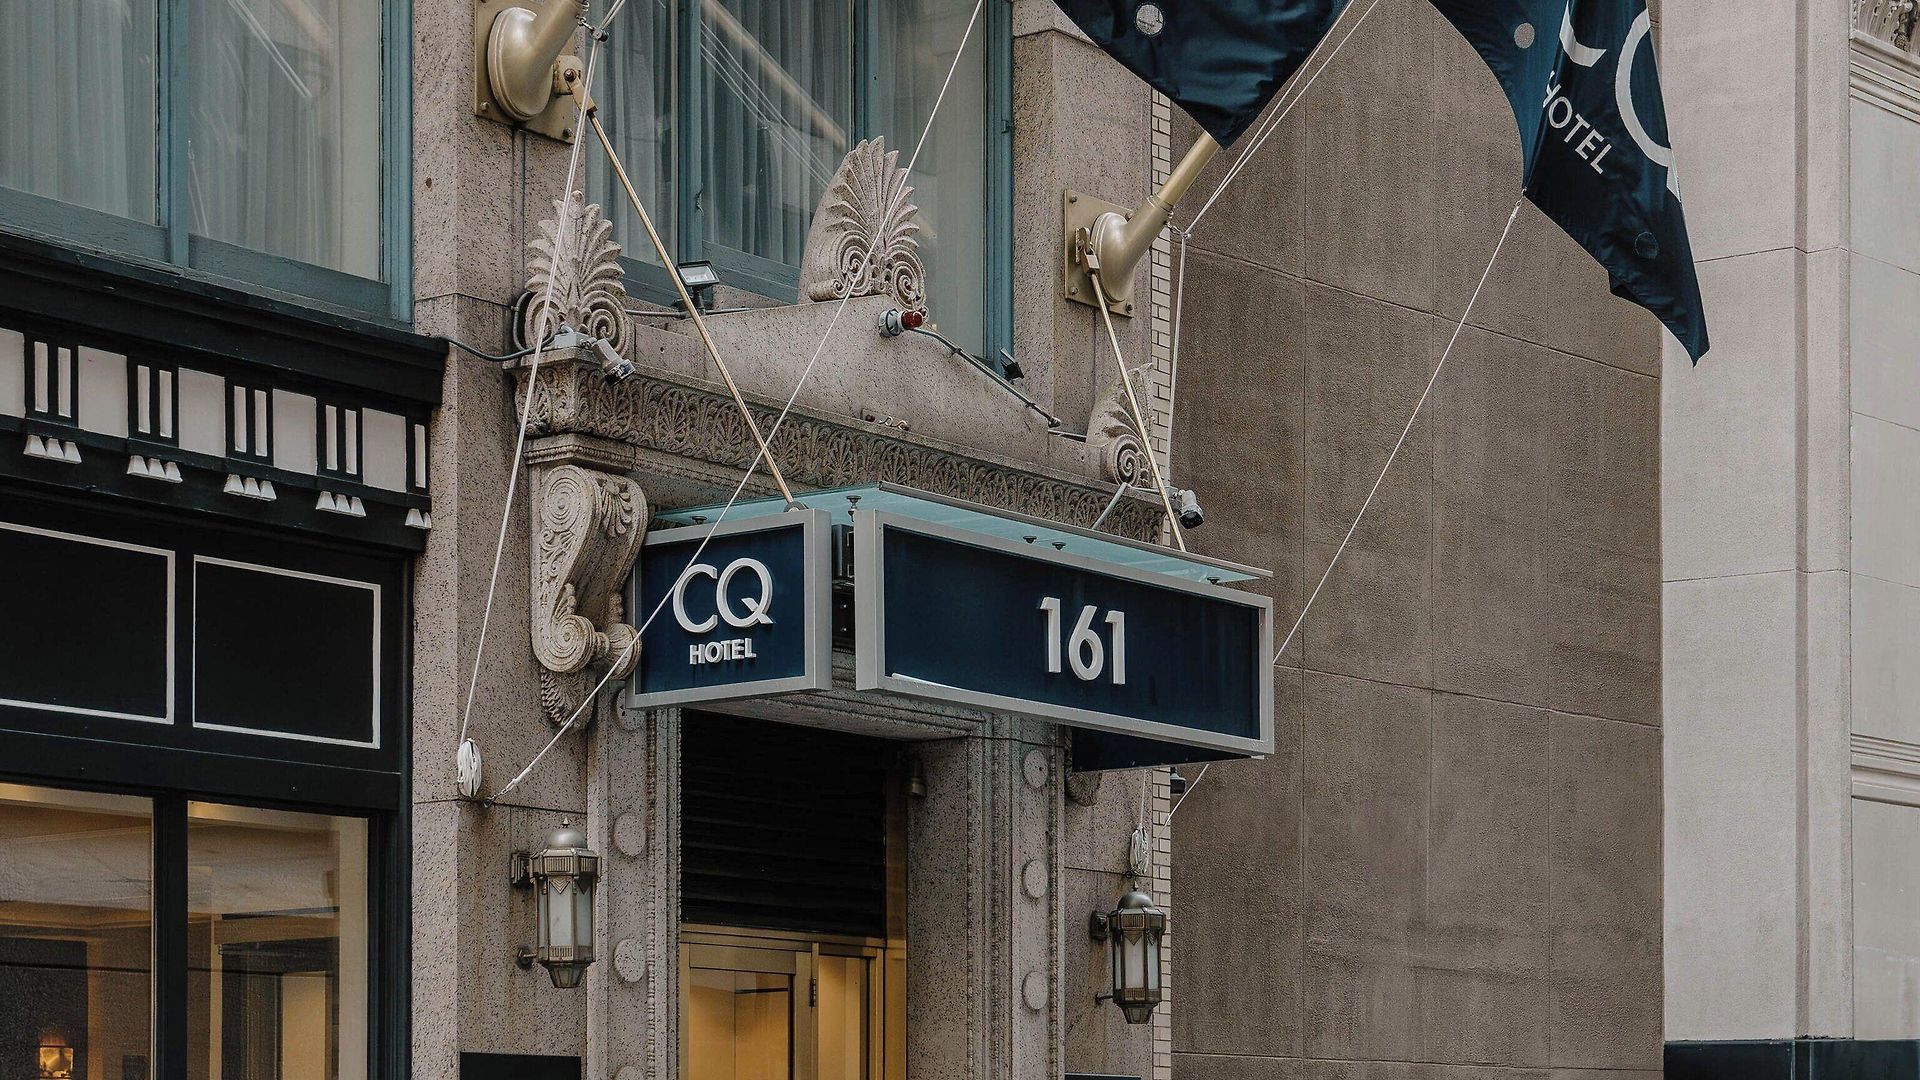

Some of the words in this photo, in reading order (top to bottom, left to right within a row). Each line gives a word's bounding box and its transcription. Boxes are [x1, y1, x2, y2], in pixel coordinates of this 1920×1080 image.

[1543, 70, 1612, 174] HOTEL
[672, 557, 775, 633] CQ
[689, 637, 757, 665] HOTEL
[1040, 596, 1126, 685] 161
